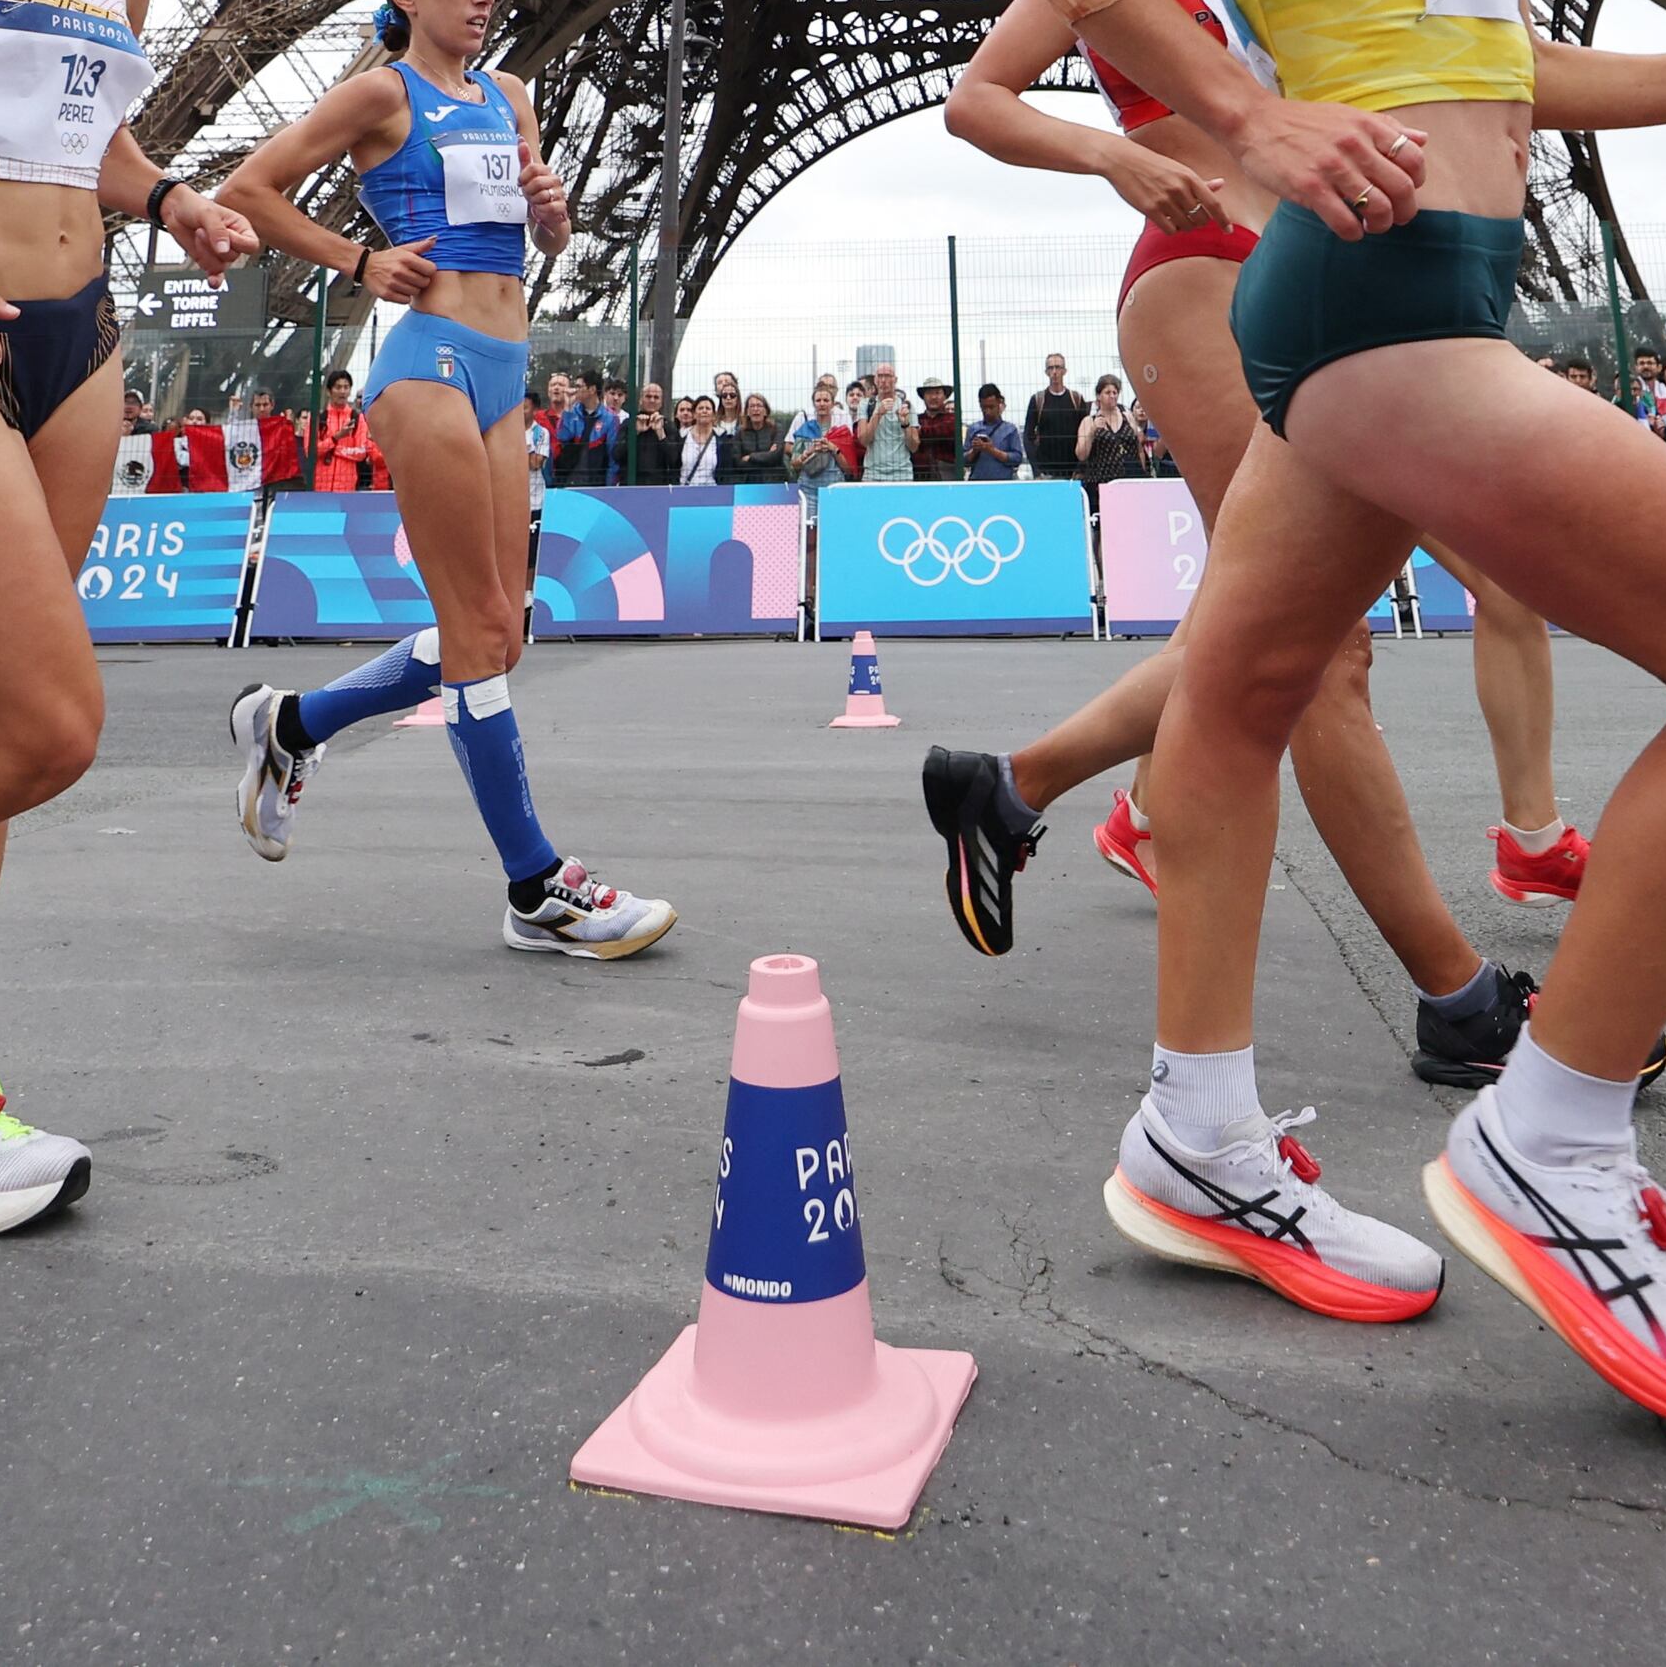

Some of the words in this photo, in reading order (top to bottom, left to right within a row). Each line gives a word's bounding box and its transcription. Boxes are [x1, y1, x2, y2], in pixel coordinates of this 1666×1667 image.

[52, 14, 95, 34] PARIS
[99, 25, 129, 44] 2024
[61, 53, 107, 98] 123
[58, 102, 95, 124] PEREZ
[462, 133, 488, 142] PARIS
[481, 154, 511, 181] 137
[164, 279, 229, 294] ENTRAA
[171, 296, 219, 311] TORRE
[170, 313, 217, 328] EIFFEL
[85, 521, 187, 559] ARIS
[77, 563, 179, 600] 024
[732, 1274, 793, 1297] MONDO
